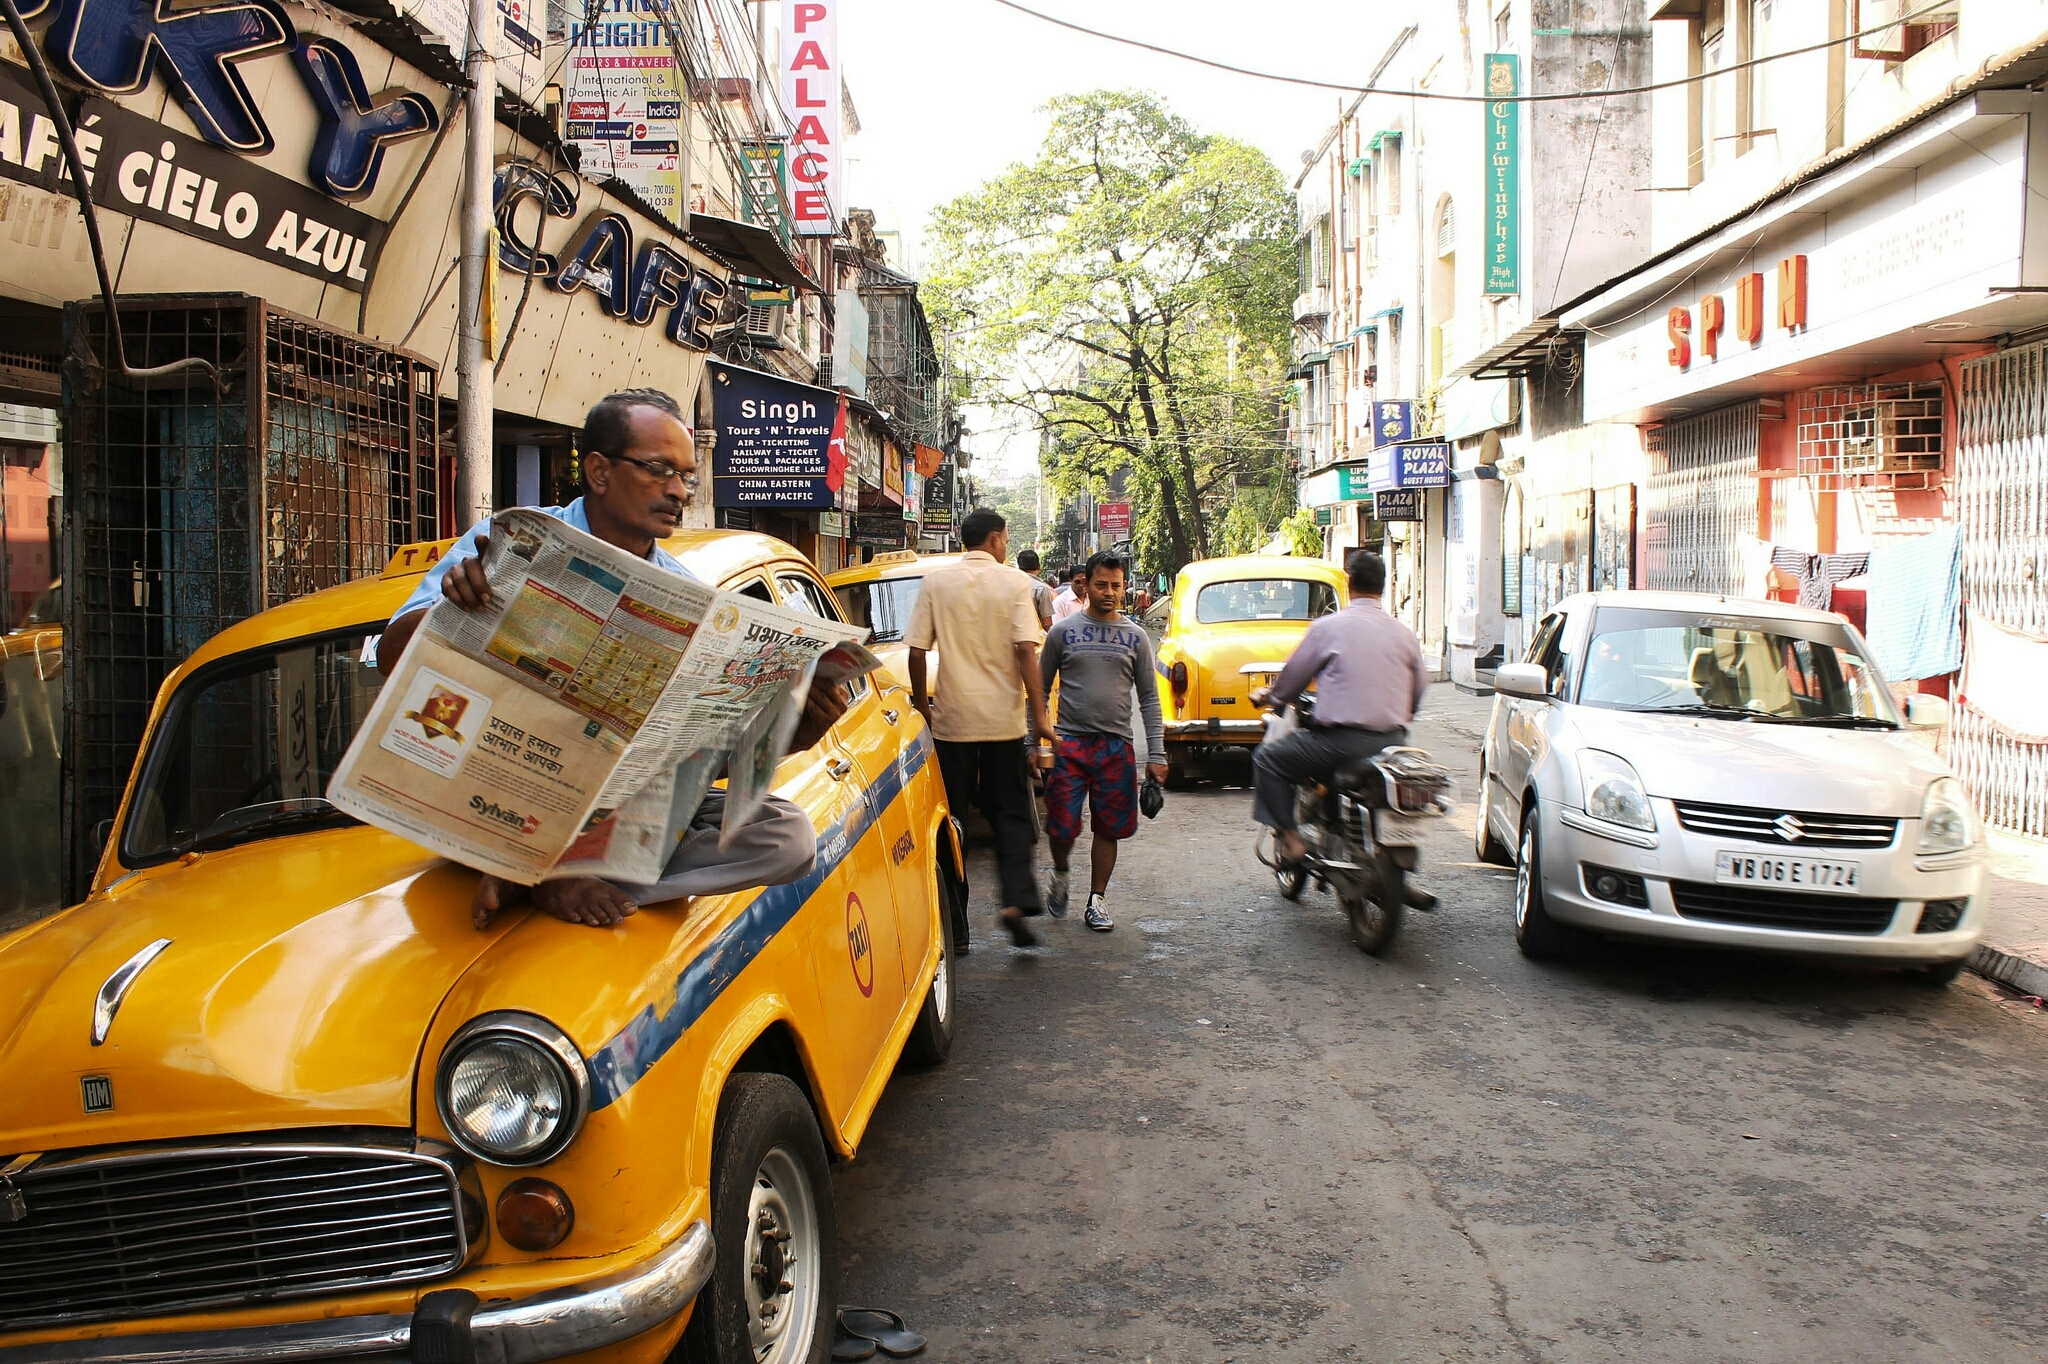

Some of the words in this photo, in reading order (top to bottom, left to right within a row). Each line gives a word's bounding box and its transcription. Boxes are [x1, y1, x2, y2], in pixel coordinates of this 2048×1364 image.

[571, 22, 681, 47] HEIGHTS
[574, 57, 610, 68] TOURS
[613, 58, 621, 68] &
[625, 57, 672, 68] TRAVELS
[582, 74, 652, 85] International
[656, 74, 665, 85] &
[568, 87, 618, 98] Domestic
[621, 87, 638, 97] Air
[642, 87, 680, 97] Tickets
[648, 104, 679, 117] IndiGo
[790, 3, 830, 221] PALACE
[575, 125, 593, 136] THAI
[602, 160, 639, 169] Emirates
[1491, 100, 1511, 264] Chowringhee
[265, 208, 368, 282] AZUL
[493, 154, 729, 353] CAFE
[1488, 278, 1515, 289] School
[1667, 254, 1808, 370] SPUN
[741, 399, 816, 424] Singh
[726, 426, 761, 436] Tours
[786, 426, 830, 436] Travels
[737, 439, 755, 447] AIR
[761, 439, 810, 447] TICKETING
[733, 449, 772, 457] RAILWAY
[788, 448, 819, 456] TICKET
[1402, 447, 1445, 461] ROYAL
[729, 457, 760, 465] TOURS
[763, 457, 771, 465] &
[775, 457, 821, 465] PACKAGES
[804, 465, 826, 473] LANE
[1403, 461, 1444, 475] PLAZA
[738, 480, 768, 488] CHINA
[770, 480, 811, 488] EASTERN
[1402, 476, 1424, 485] GUEST
[1424, 475, 1446, 485] HOUSE
[738, 492, 772, 501] CATHAY
[775, 492, 814, 500] PACIFIC
[1379, 493, 1414, 506] PLAZA
[877, 552, 909, 562] TAXI
[489, 716, 525, 742] प्रयास
[527, 734, 563, 759] हमारा
[523, 750, 564, 775] आपका
[1791, 862, 1802, 883] E
[849, 918, 869, 962] TAXI
[86, 1081, 110, 1107] HM
